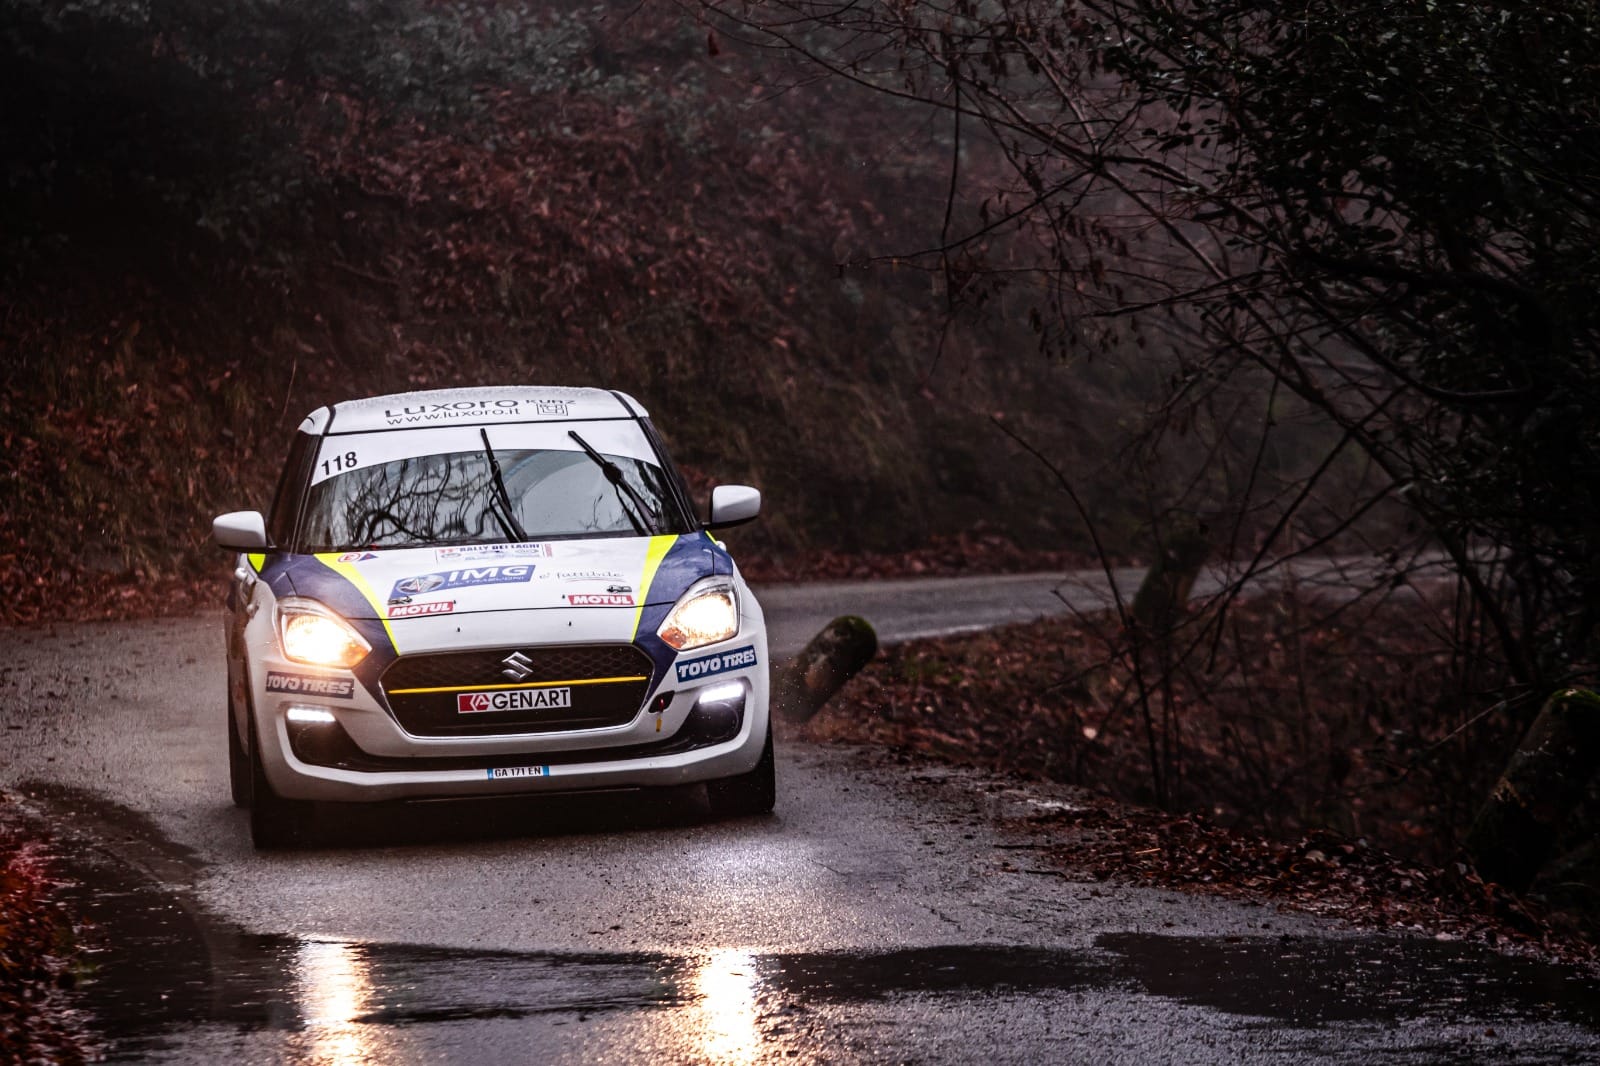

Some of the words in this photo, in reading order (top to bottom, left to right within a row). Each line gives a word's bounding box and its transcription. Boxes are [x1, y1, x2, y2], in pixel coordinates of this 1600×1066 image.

[387, 408, 520, 425] www.luxoro.it
[321, 451, 357, 476] 118
[448, 565, 529, 582] IMG
[573, 595, 631, 604] MOTUL
[390, 602, 451, 617] MOTUL
[678, 657, 721, 678] TOYO
[722, 649, 755, 668] TIRES
[267, 674, 298, 690] TOYO
[301, 678, 351, 695] TIRES
[492, 688, 569, 709] GENART
[495, 768, 508, 777] GA
[511, 767, 525, 777] 171
[528, 766, 541, 775] EN
